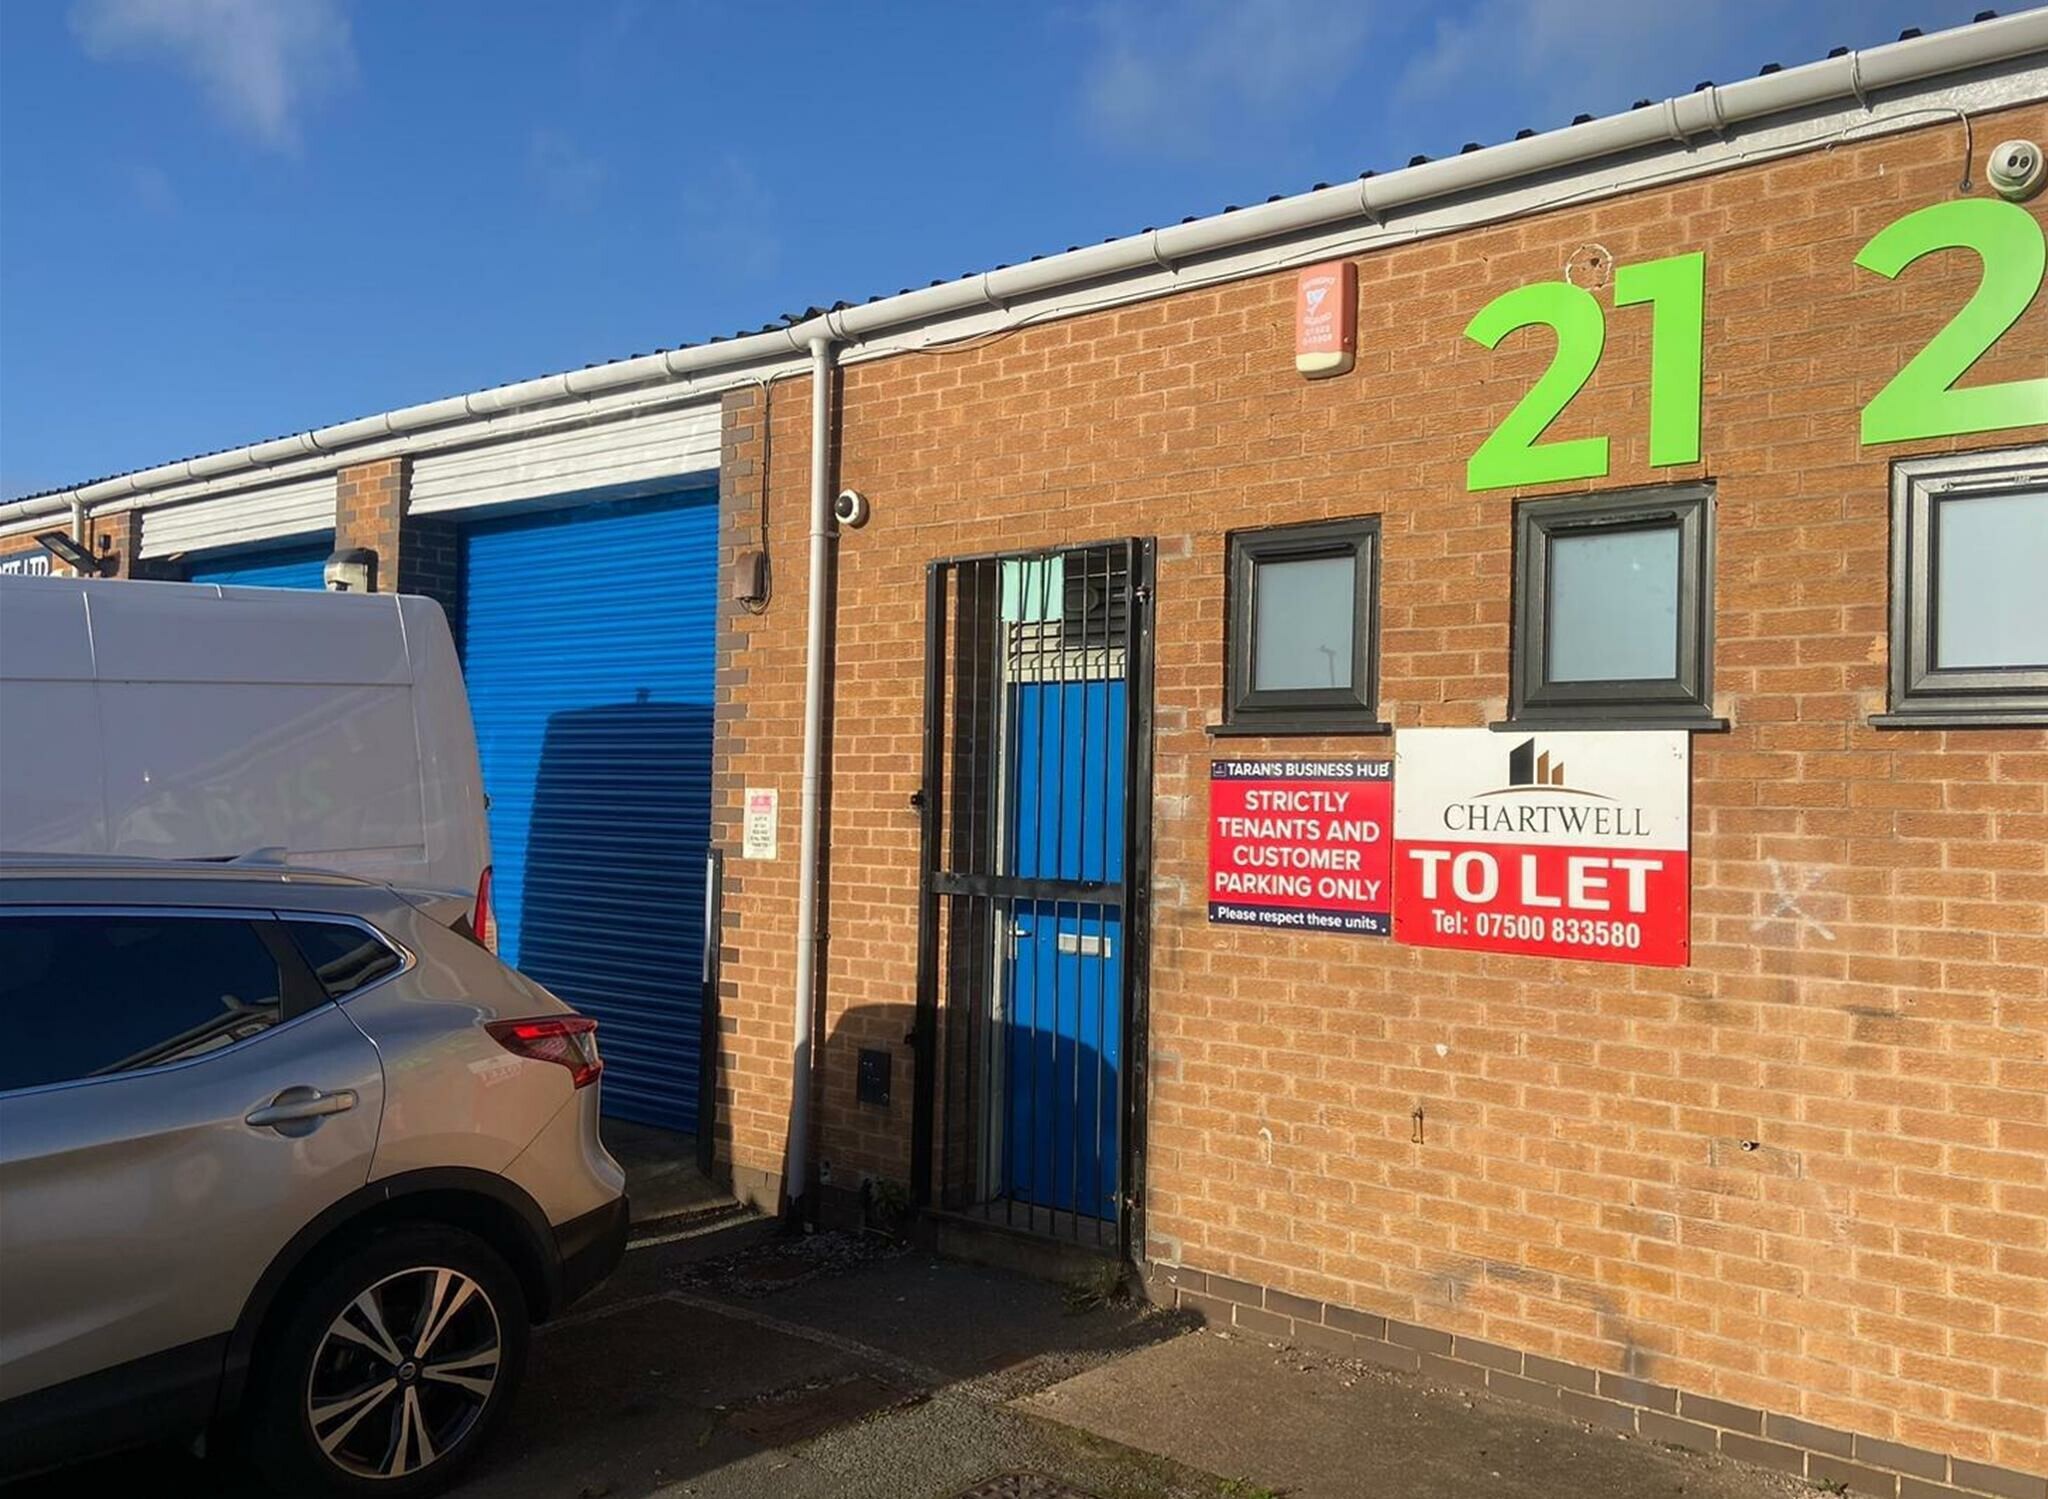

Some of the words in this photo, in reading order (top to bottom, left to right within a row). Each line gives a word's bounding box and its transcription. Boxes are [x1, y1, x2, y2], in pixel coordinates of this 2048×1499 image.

[1463, 251, 1705, 492] 21
[1228, 763, 1283, 776] TARAN'S
[1286, 763, 1353, 777] BUSINESS
[1357, 764, 1389, 777] HUB
[1245, 790, 1349, 812] STRICTLY
[1217, 817, 1321, 841] TENANTS
[1326, 820, 1380, 843] AND
[1443, 803, 1651, 837] CHARTWELL
[1233, 845, 1361, 871] CUSTOMER
[1215, 872, 1312, 898] PARKING
[1318, 877, 1381, 901] ONLY
[1409, 849, 1499, 904] TO
[1520, 854, 1664, 914] LET
[1218, 906, 1257, 921] Please
[1259, 911, 1304, 926] respect
[1307, 913, 1342, 927] these
[1345, 916, 1377, 930] units
[1432, 909, 1469, 935] Tel:
[1476, 911, 1545, 941] 07500
[1551, 918, 1641, 949] 833580
